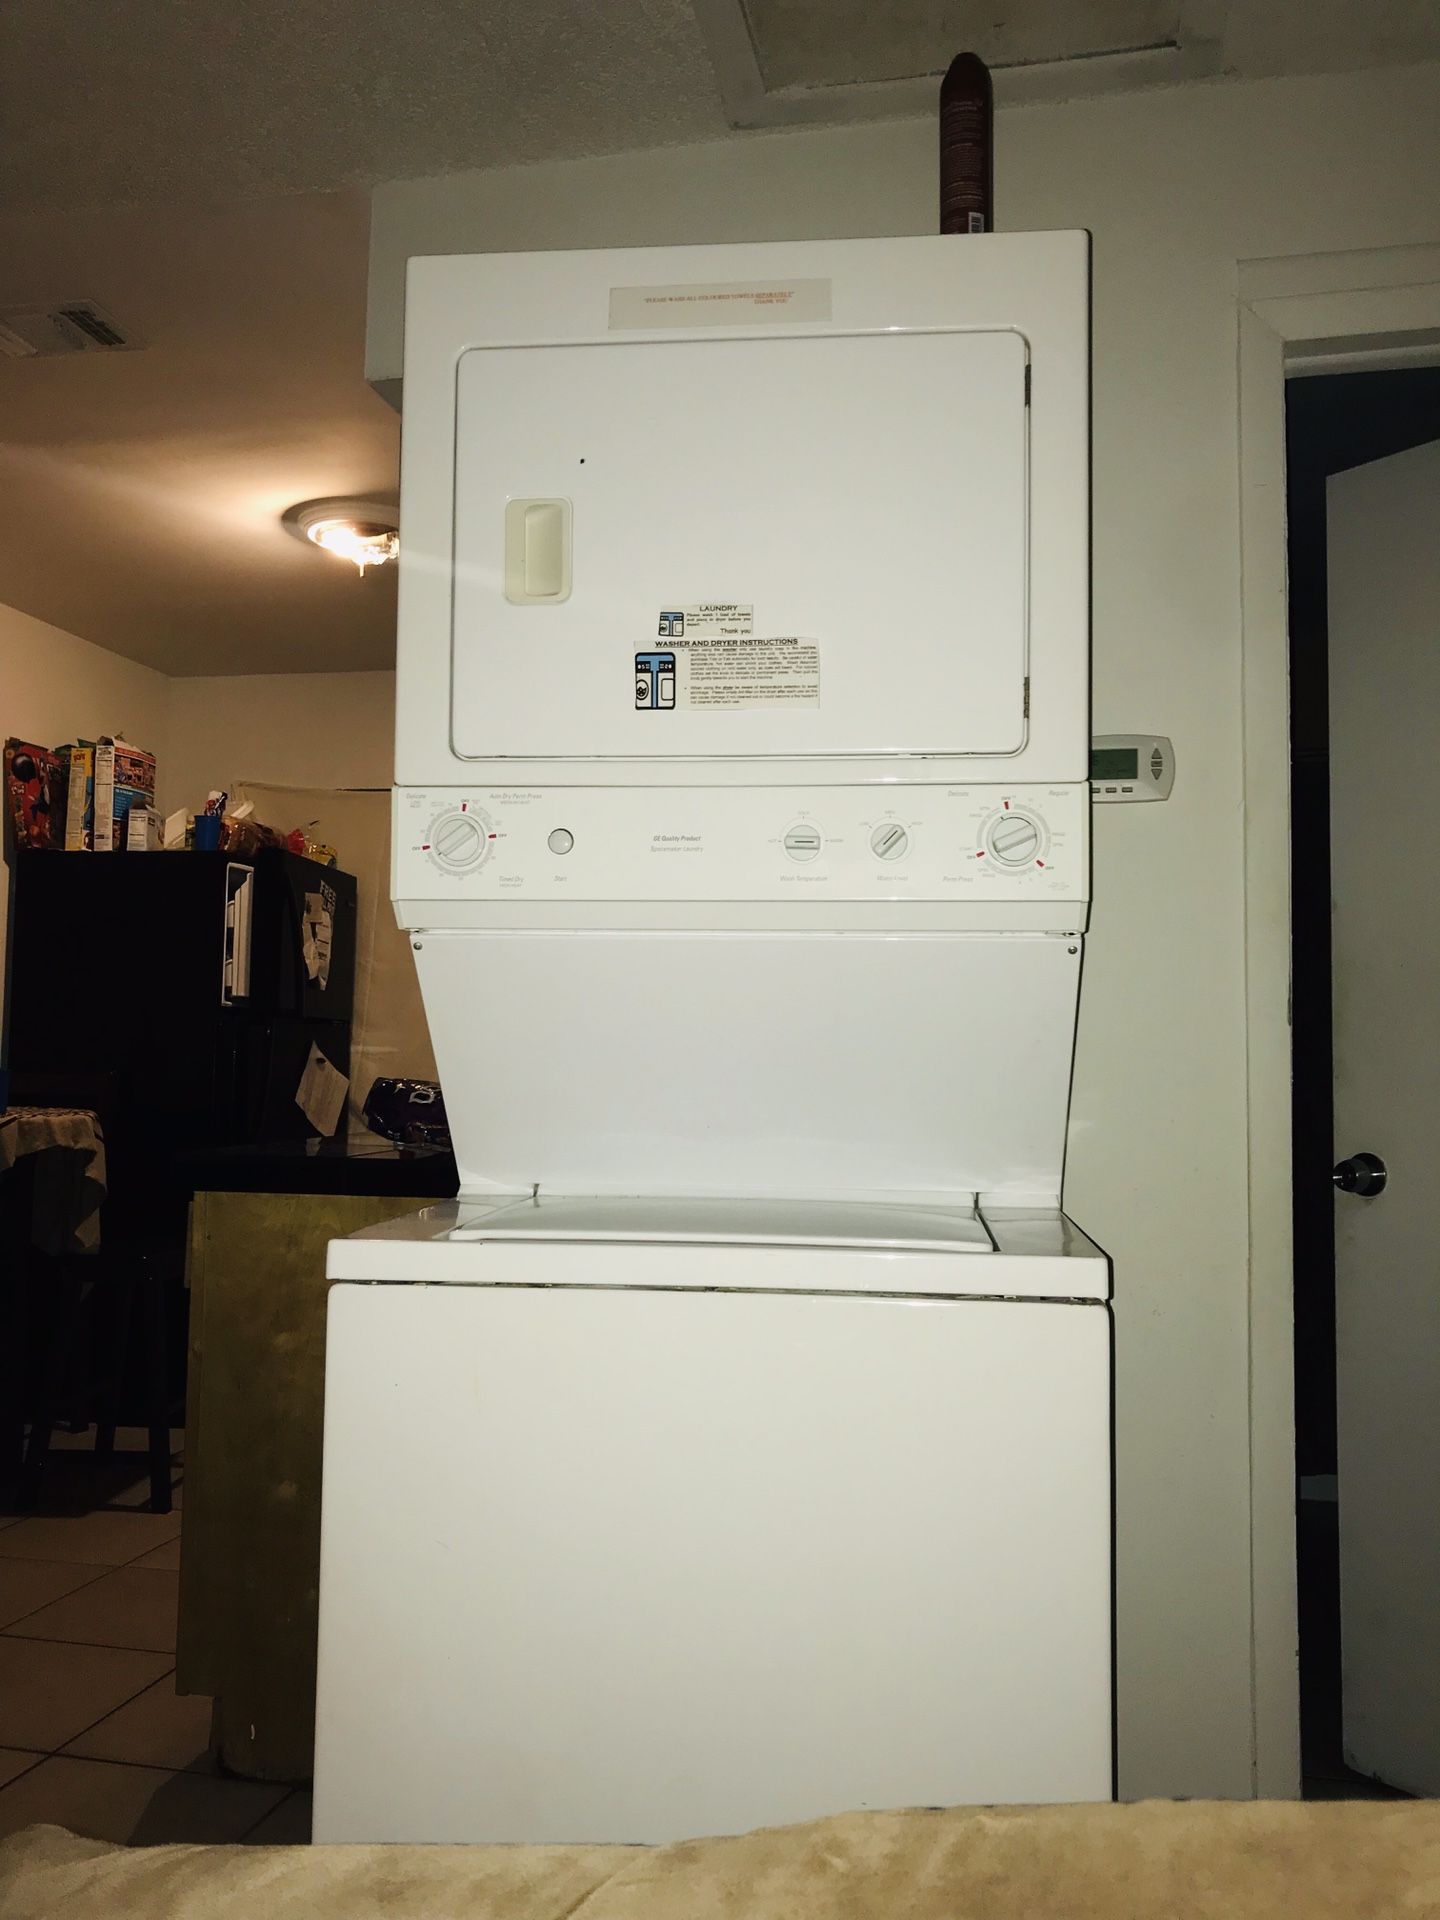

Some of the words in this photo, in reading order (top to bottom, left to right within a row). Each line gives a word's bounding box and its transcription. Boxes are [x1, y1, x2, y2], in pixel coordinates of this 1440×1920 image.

[739, 638, 798, 646] INSTRUCTIONS
[661, 835, 679, 843] Quality
[683, 845, 704, 853] Laundry
[554, 874, 567, 882] Start
